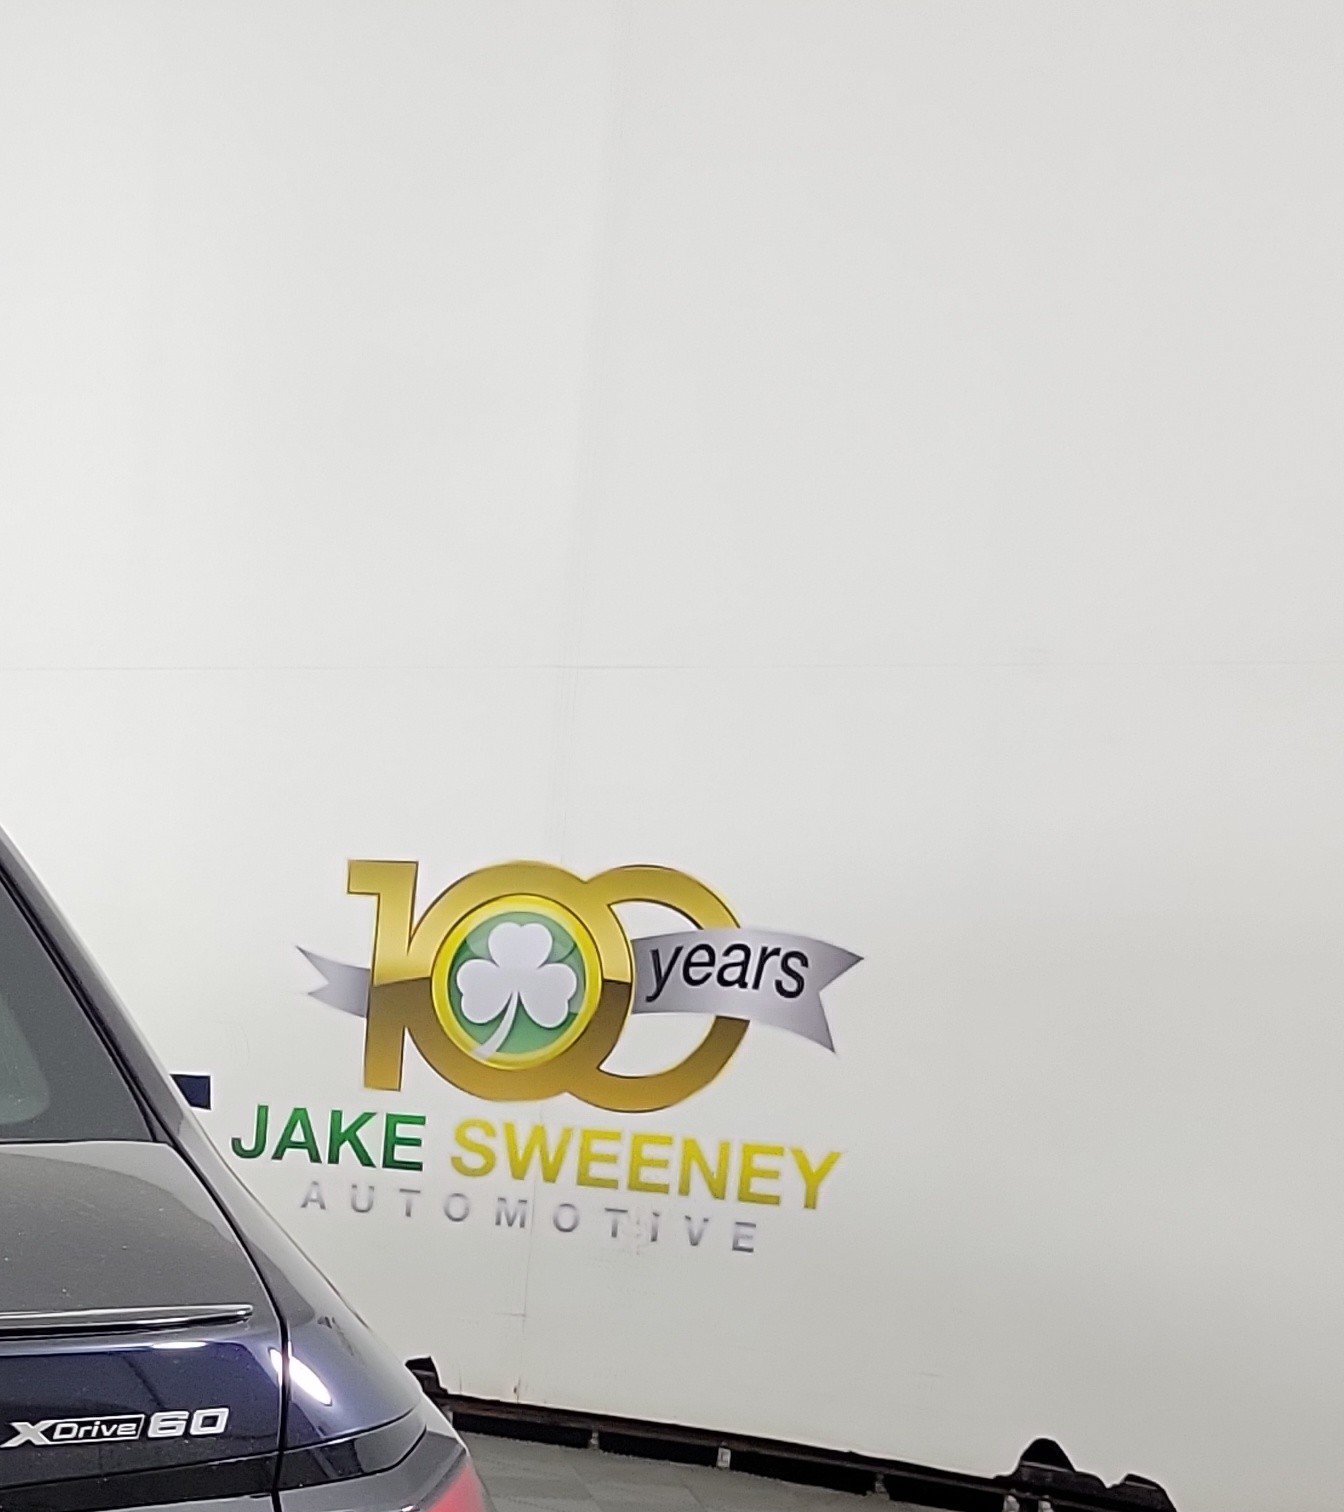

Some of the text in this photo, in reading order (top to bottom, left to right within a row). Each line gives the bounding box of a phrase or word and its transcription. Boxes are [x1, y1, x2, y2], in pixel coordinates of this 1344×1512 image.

[645, 941, 810, 1002] years
[231, 1104, 842, 1212] JAKE SWEENEY
[300, 1180, 759, 1253] AUTOMOTIVE
[147, 1407, 230, 1438] 60
